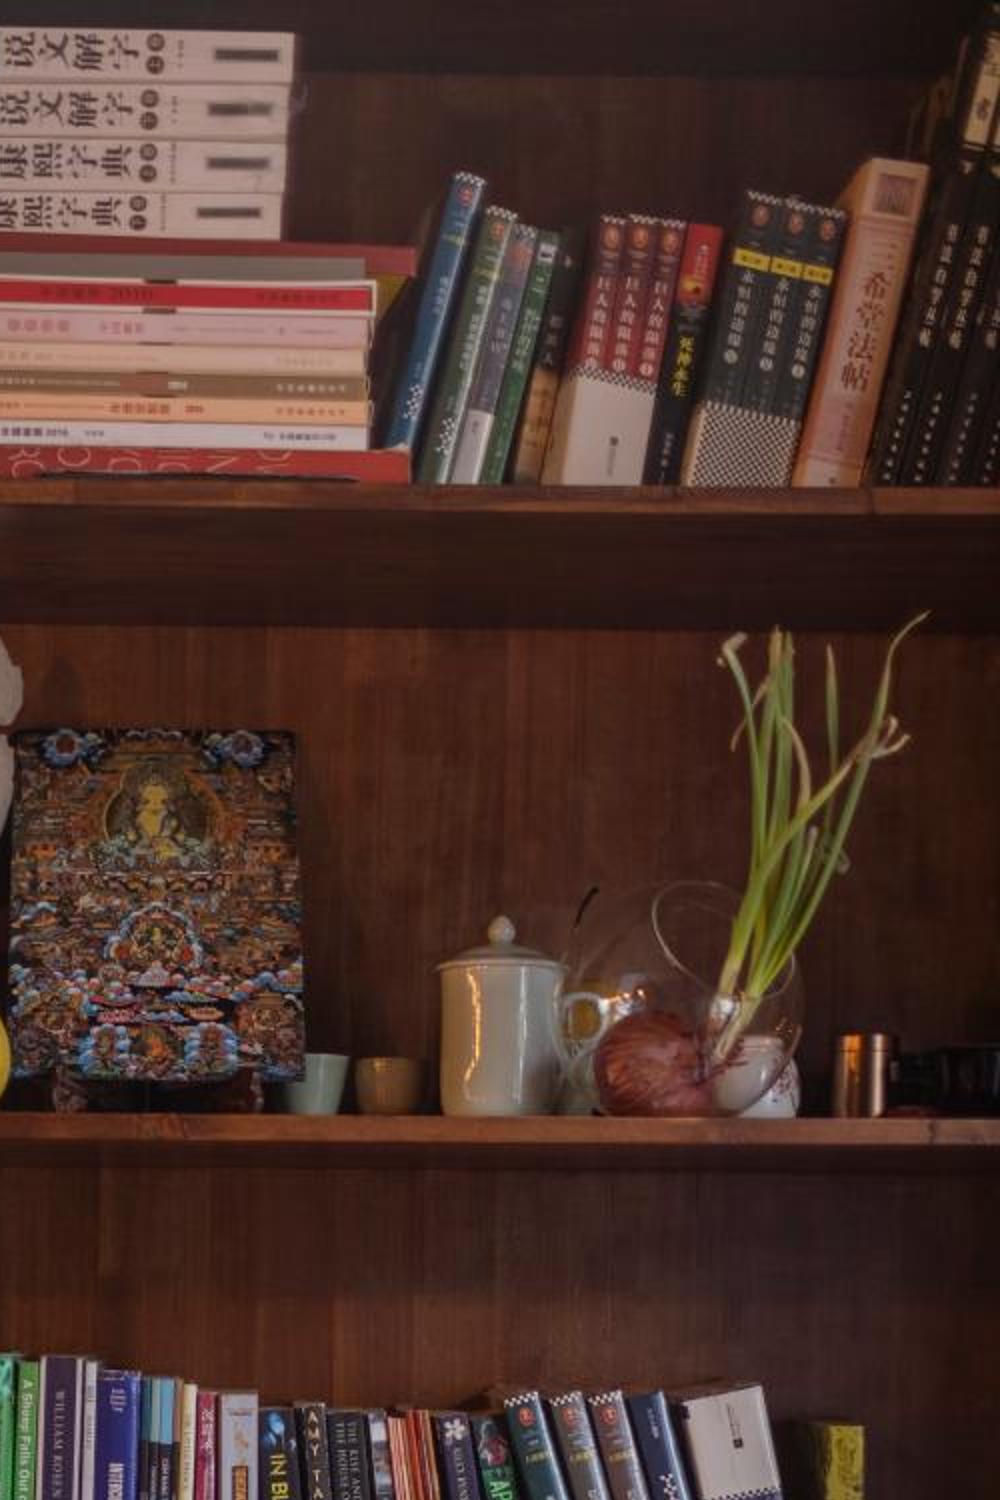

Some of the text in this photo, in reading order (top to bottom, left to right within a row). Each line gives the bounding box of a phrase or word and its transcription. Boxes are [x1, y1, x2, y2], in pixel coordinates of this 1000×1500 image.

[4, 30, 140, 72] 说文解字
[0, 89, 135, 128] 说文解字
[22, 1379, 32, 1389] A
[19, 1392, 32, 1433] Sheep
[51, 1390, 65, 1499] WILLIAM ROSEN
[307, 1409, 321, 1457] AMY
[334, 1422, 346, 1444] THE
[346, 1420, 358, 1443] THE
[18, 1435, 30, 1467] Falls
[269, 1453, 288, 1475] IN
[348, 1449, 360, 1474] RISE
[17, 1468, 30, 1491] Out
[336, 1449, 350, 1489] HOUSE
